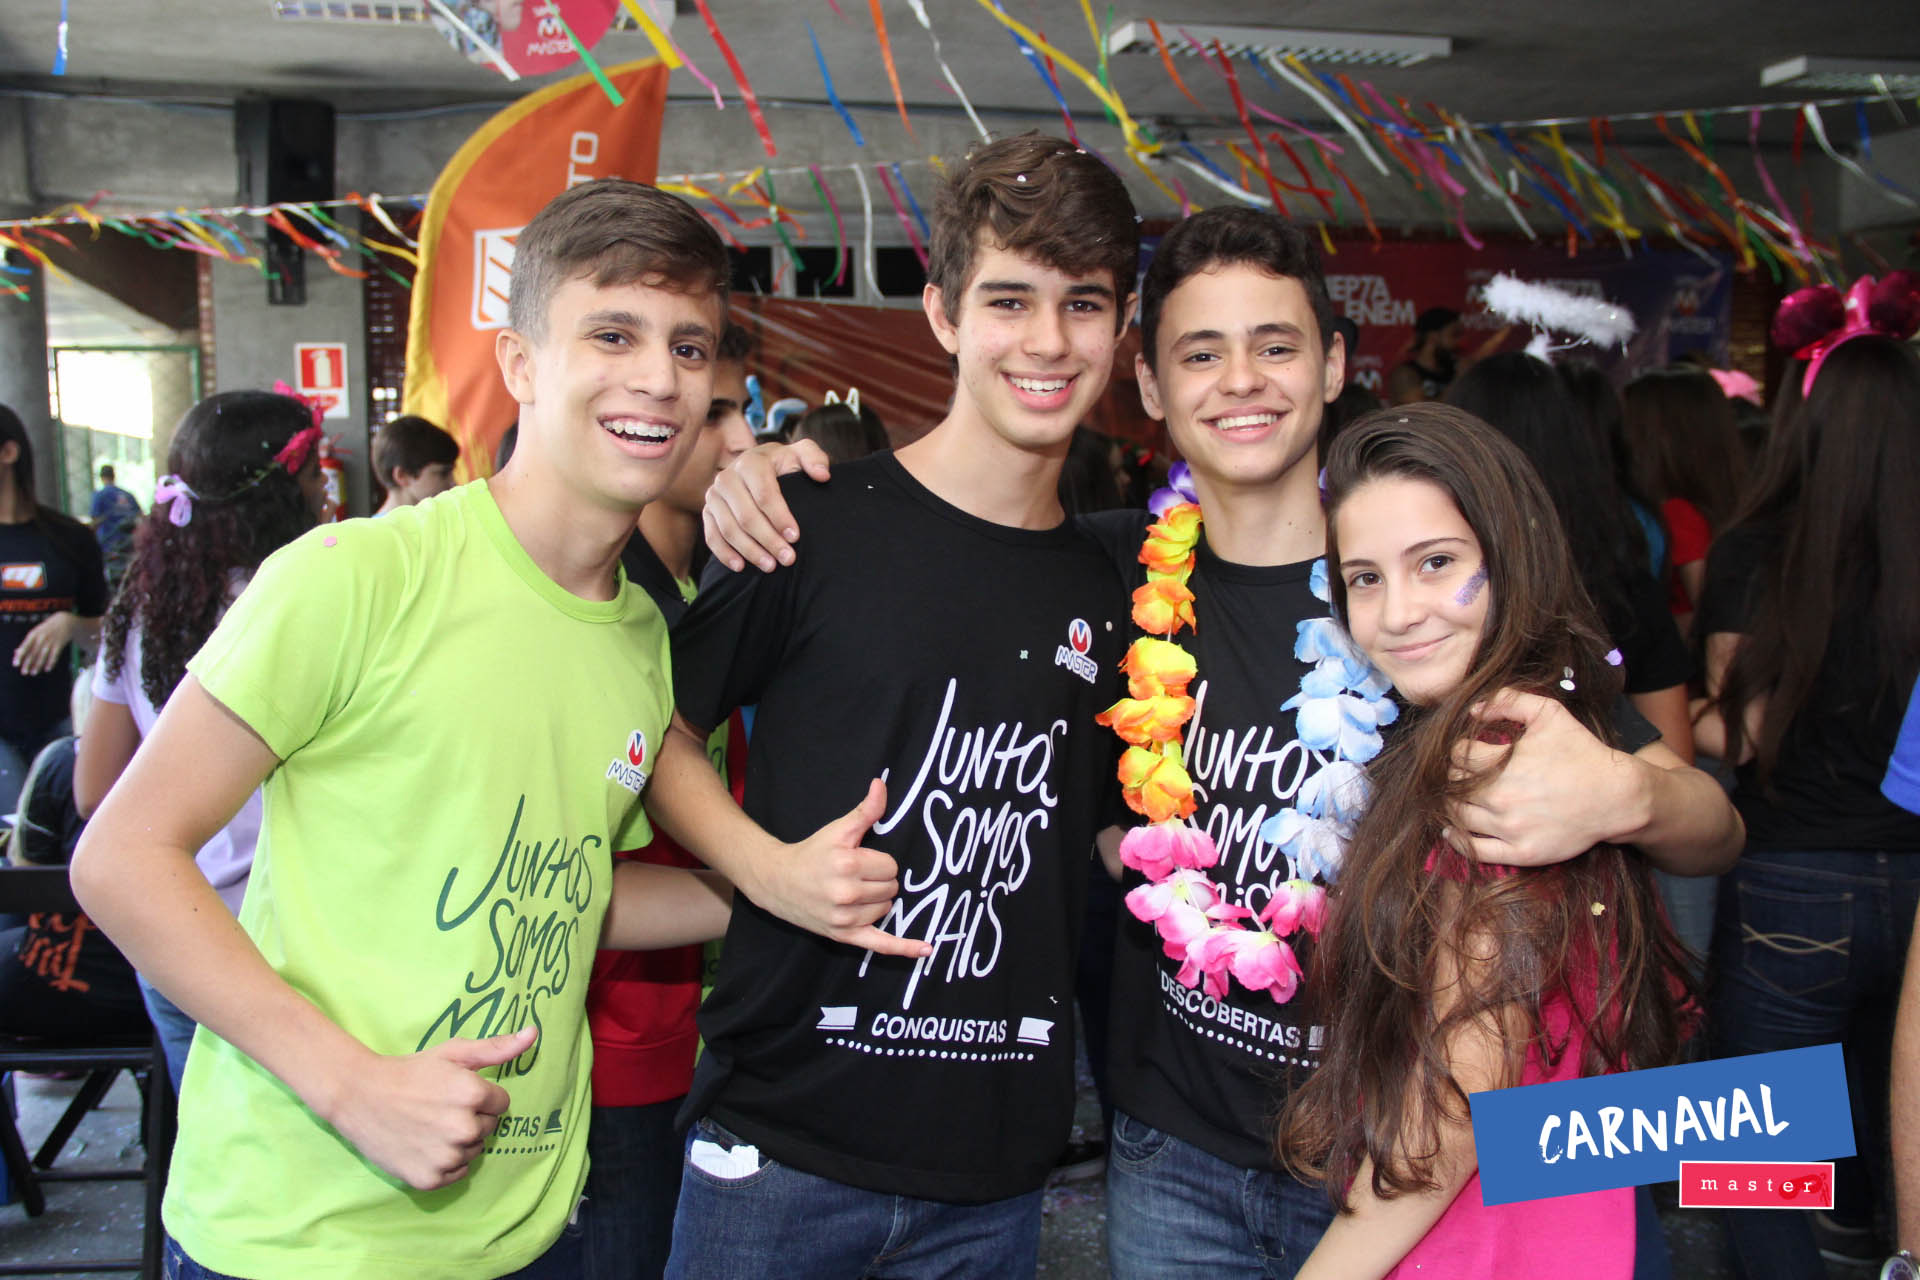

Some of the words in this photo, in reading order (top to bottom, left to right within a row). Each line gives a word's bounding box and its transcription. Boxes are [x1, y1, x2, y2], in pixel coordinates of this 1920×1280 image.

[1324, 274, 1391, 303] ERTA
[1055, 645, 1098, 683] MASTER
[873, 678, 1068, 836] JUNTOS
[1182, 680, 1330, 800] JUNTO
[435, 794, 602, 932] JUNTOS
[904, 788, 1049, 893] SOMOS
[465, 899, 579, 995] SOMOS
[871, 1012, 1008, 1043] CONQUISTAS
[1160, 969, 1302, 1049] DESCOBERTAS
[493, 1115, 541, 1138] ISTAS
